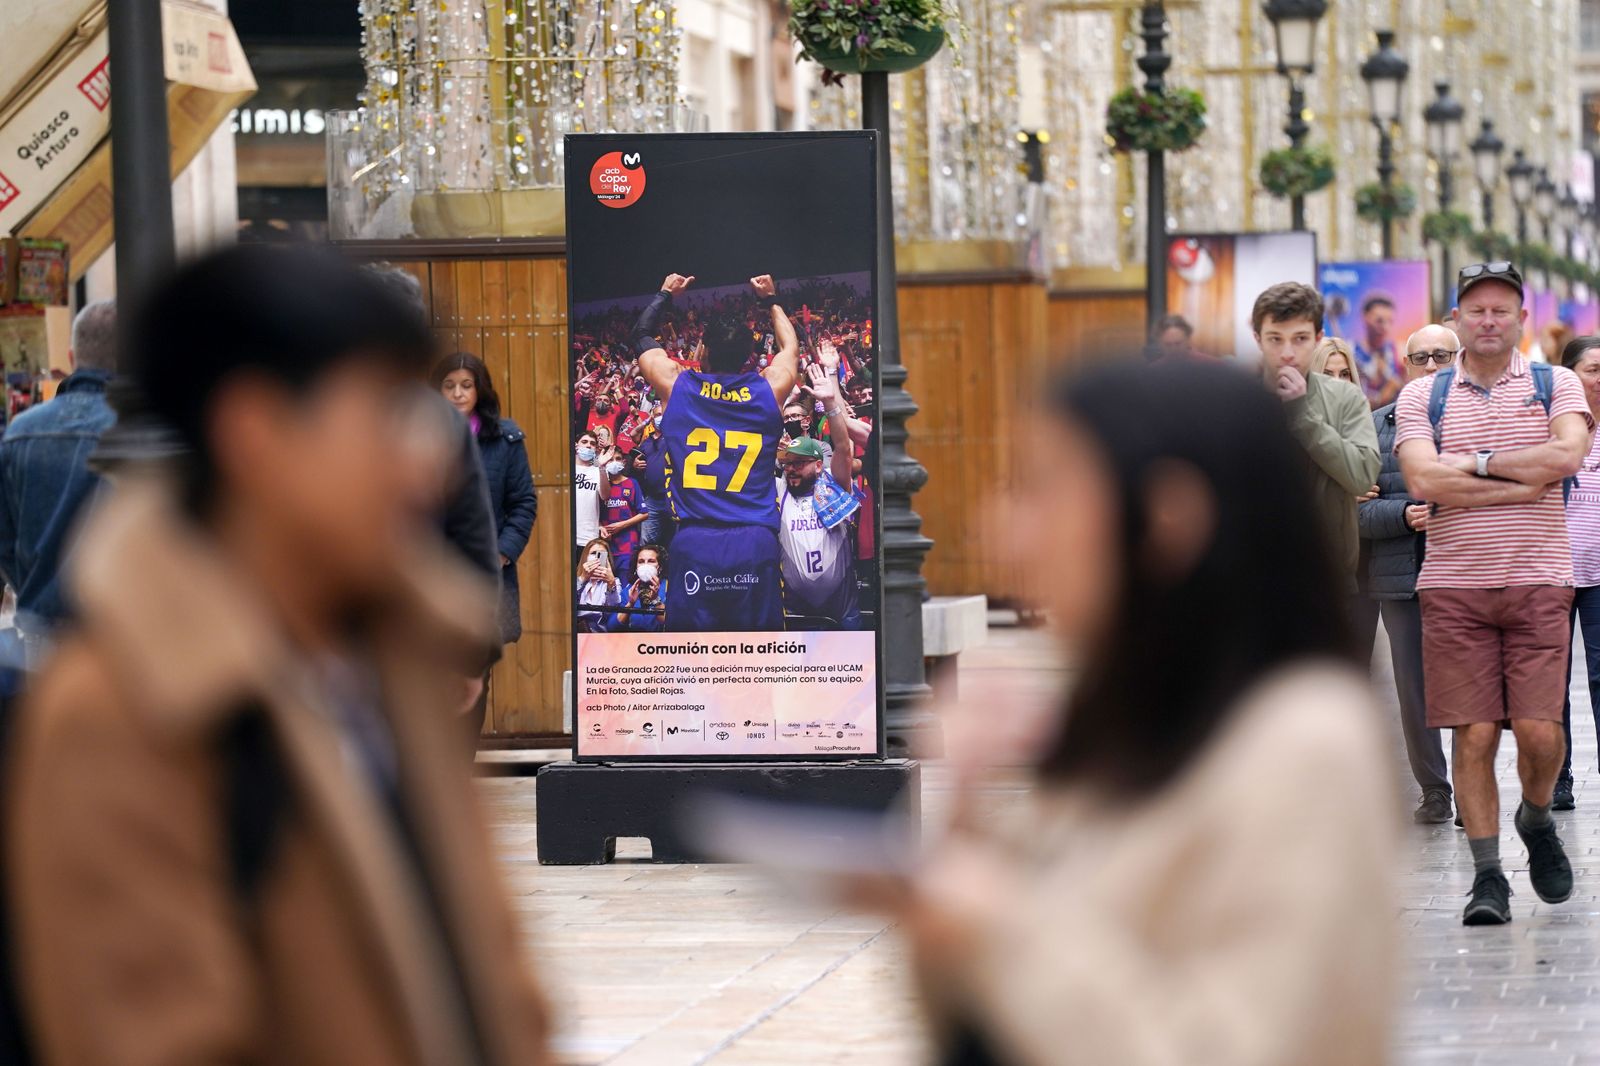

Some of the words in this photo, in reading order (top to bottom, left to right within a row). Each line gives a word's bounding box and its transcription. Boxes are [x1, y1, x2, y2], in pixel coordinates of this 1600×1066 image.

[17, 110, 69, 160] Quiosco
[34, 126, 79, 170] Arturo
[599, 174, 628, 183] Copa
[613, 184, 632, 194] Rey
[699, 381, 752, 403] ROJAS
[682, 427, 763, 493] 27
[806, 550, 823, 573] 12
[704, 575, 731, 584] Costa
[637, 642, 708, 654] Comunión
[712, 644, 737, 654] con
[740, 642, 754, 654] la
[757, 641, 806, 654] afición
[586, 666, 597, 674] La
[598, 666, 610, 674] de
[612, 666, 652, 674] Granada
[676, 665, 690, 673] fue
[710, 664, 743, 673] edición
[744, 666, 764, 674] muy
[764, 664, 802, 674] especial
[804, 666, 826, 674] para
[827, 664, 836, 672] el
[837, 664, 864, 672] UCAM
[586, 676, 618, 685] Murcia,
[620, 678, 642, 686] cuya
[644, 676, 674, 684] afición
[676, 676, 696, 684] vivió
[712, 676, 752, 685] perfecta
[754, 675, 798, 683] comunión
[829, 674, 864, 684] equipo.
[609, 688, 629, 696] foto,
[630, 686, 658, 694] Sadiel
[660, 687, 686, 696] Rojas.
[652, 704, 705, 712] Arrizabalaga
